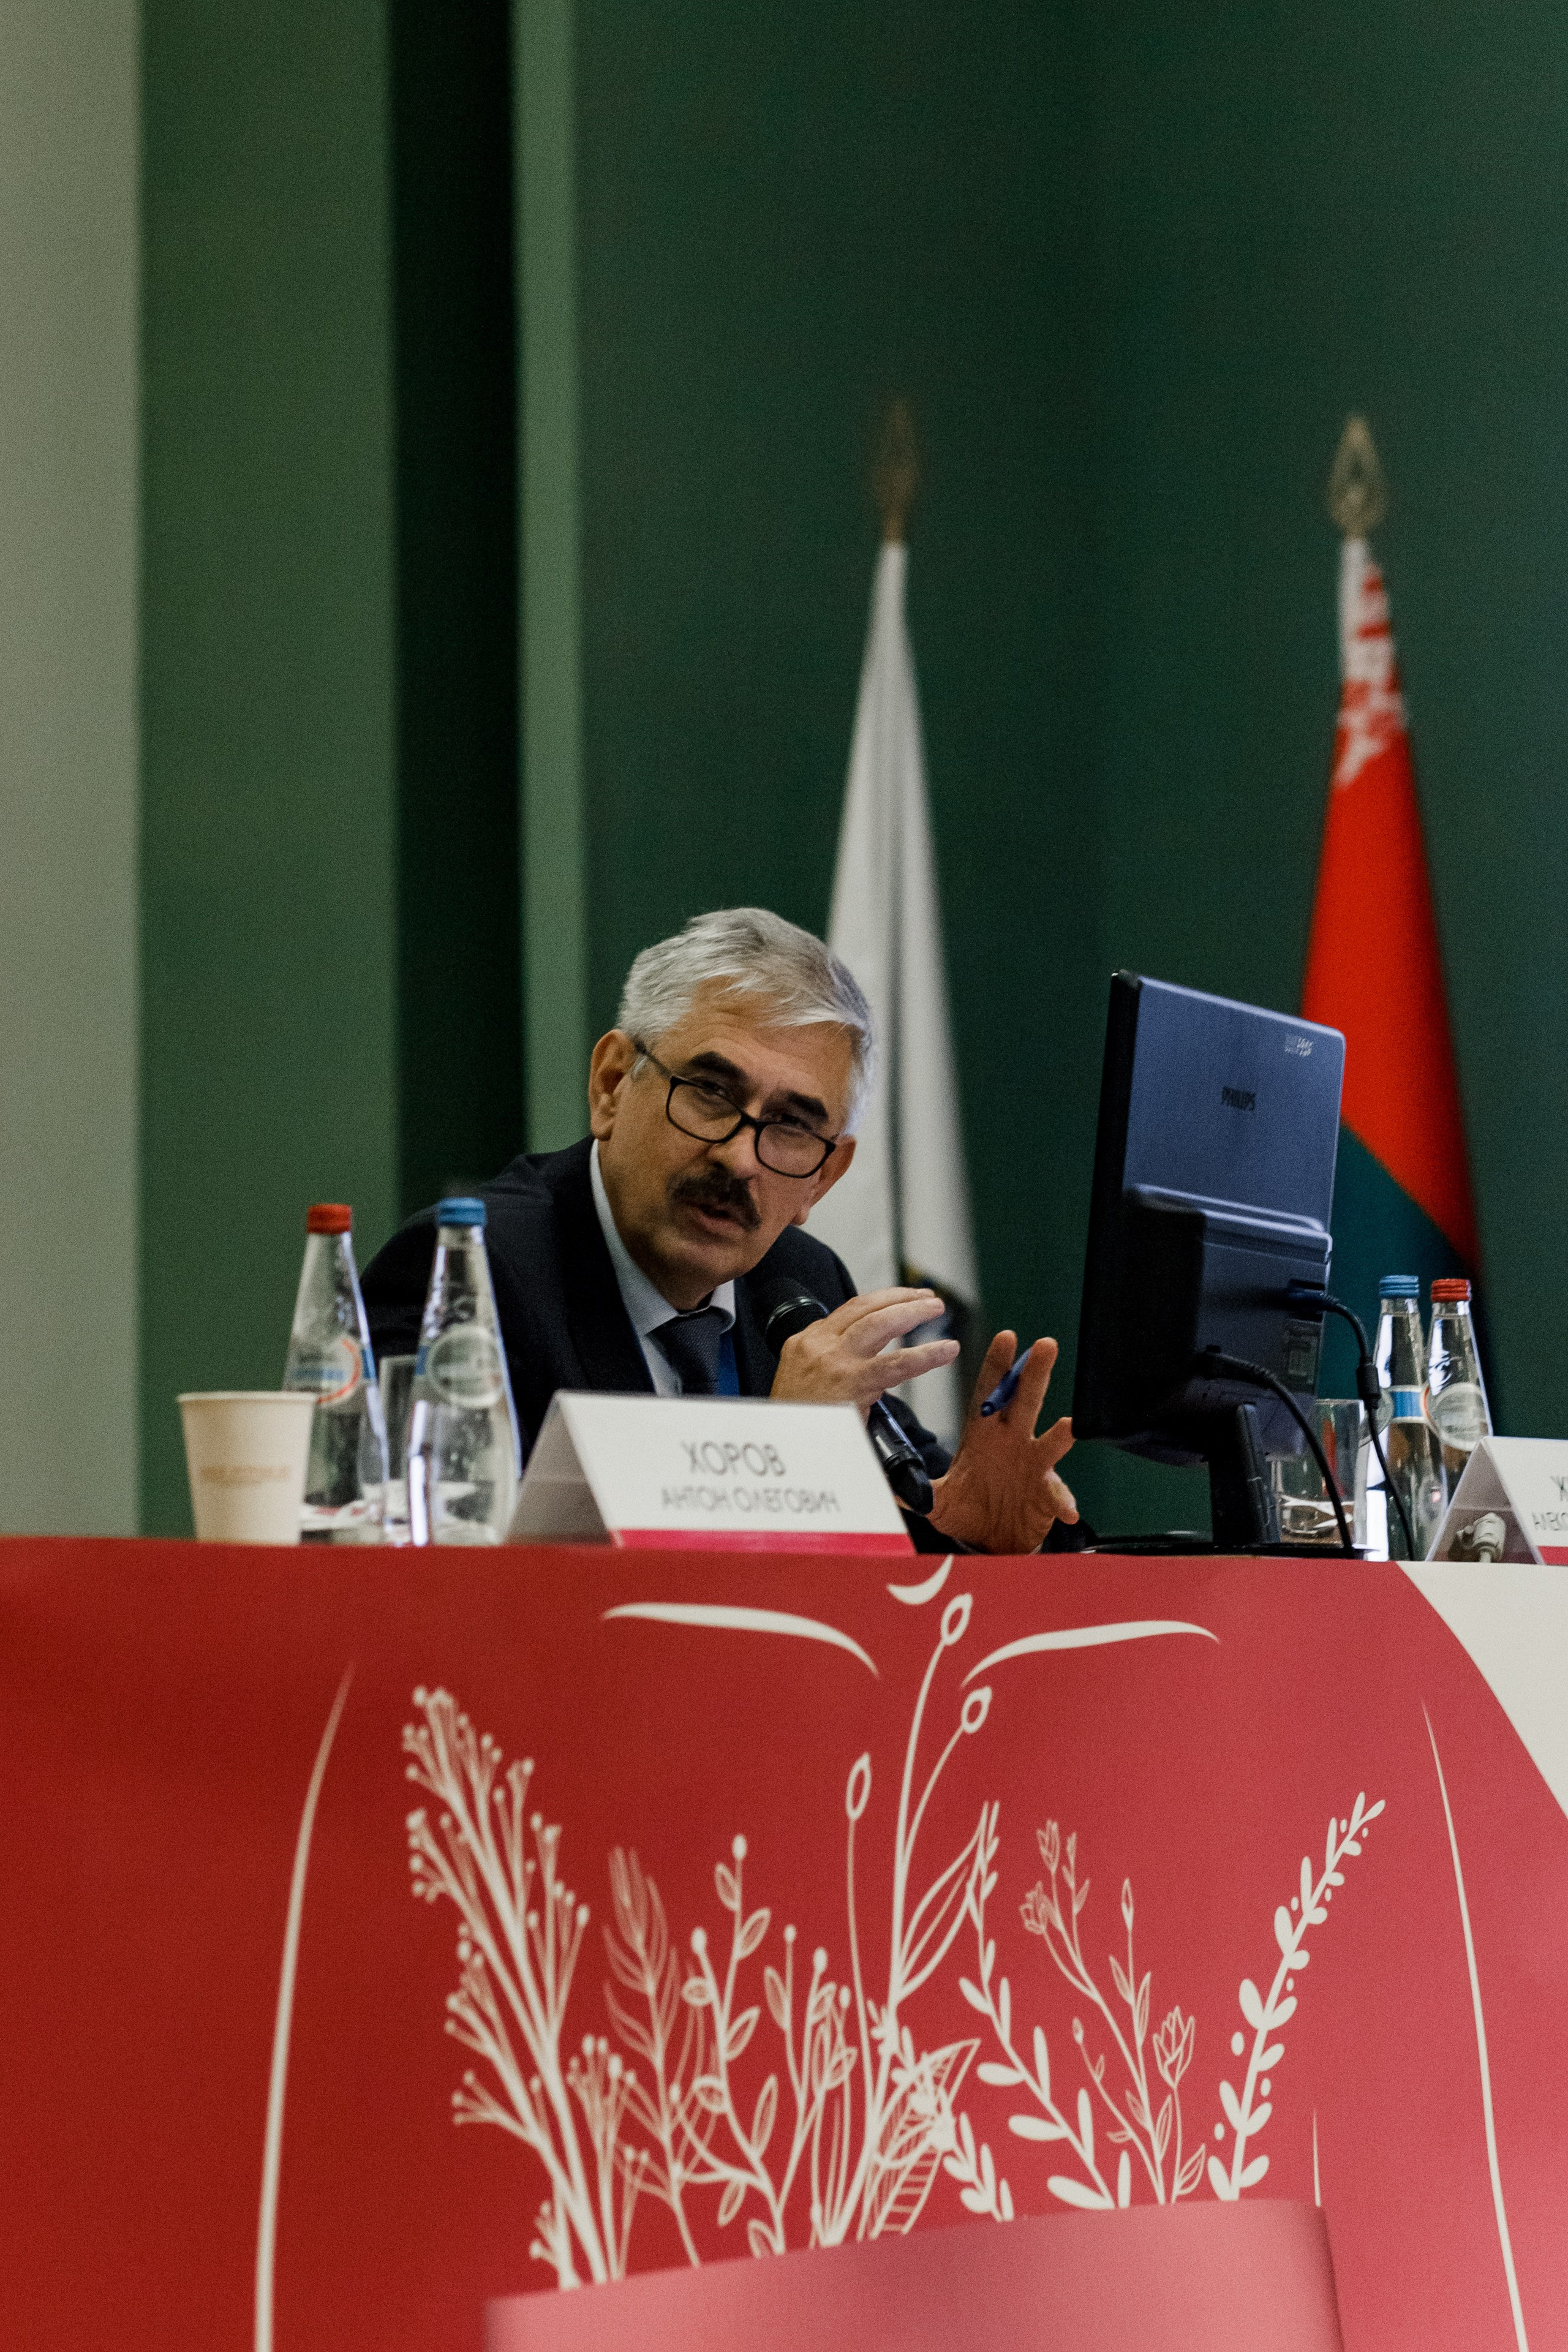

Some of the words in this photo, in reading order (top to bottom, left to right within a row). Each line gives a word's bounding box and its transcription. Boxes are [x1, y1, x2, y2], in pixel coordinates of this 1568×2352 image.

[680, 1440, 786, 1477] ХОРОВ
[661, 1485, 733, 1512] АНТОН
[734, 1486, 841, 1513] ОЛЕГОВИЧ
